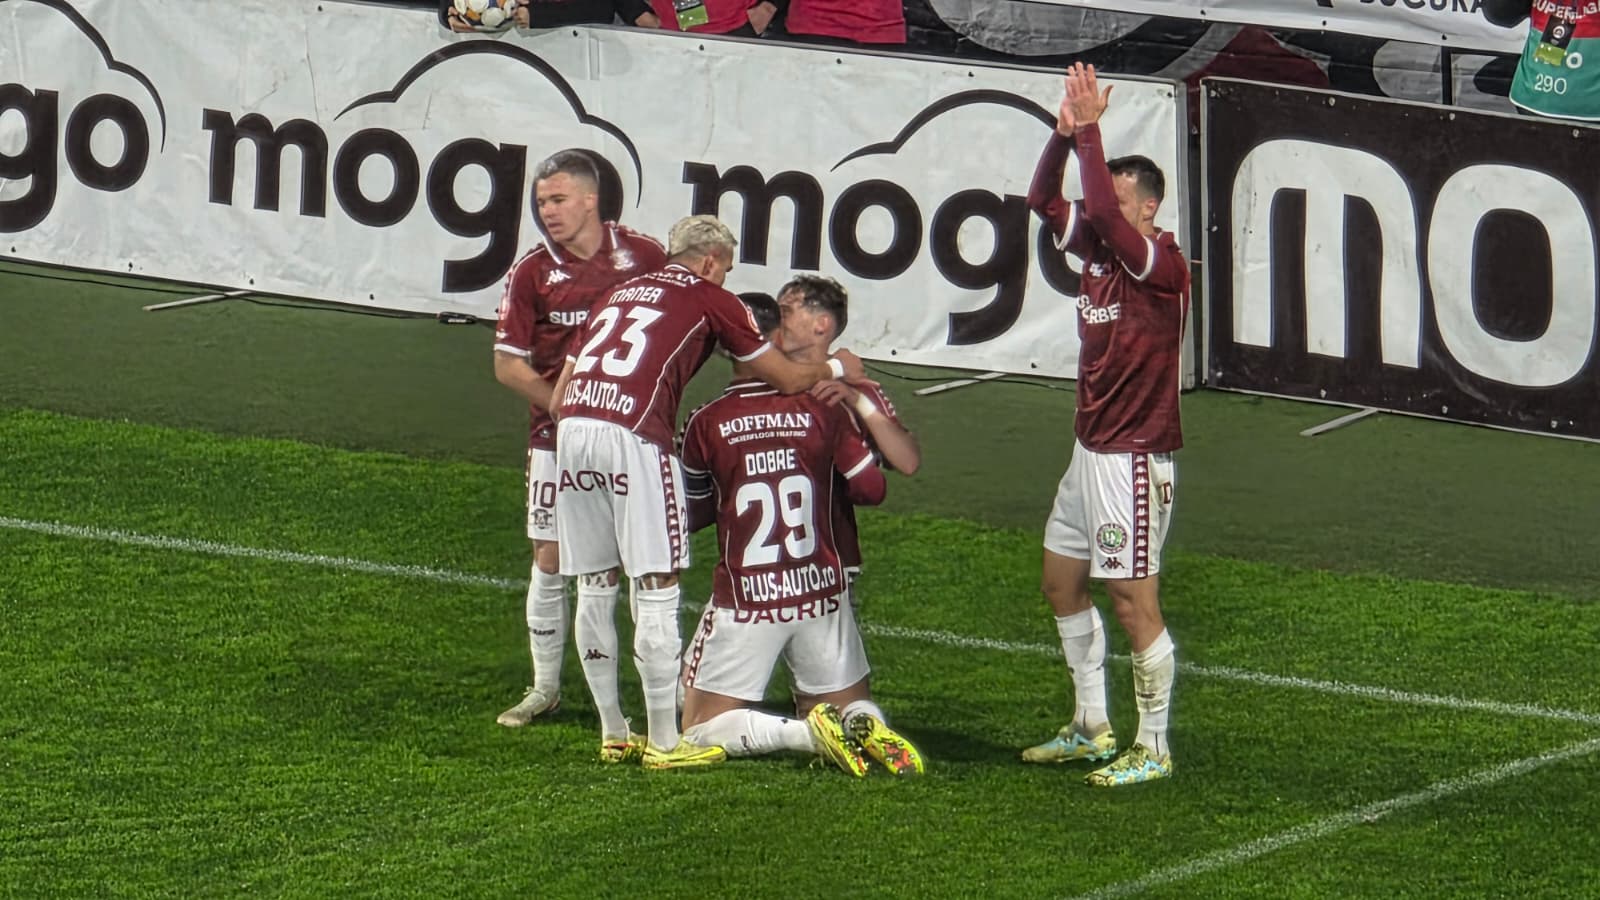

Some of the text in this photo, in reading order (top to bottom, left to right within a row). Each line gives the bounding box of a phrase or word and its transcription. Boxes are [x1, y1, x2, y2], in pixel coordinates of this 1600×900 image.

[1534, 73, 1567, 95] 290
[607, 286, 664, 305] MANEA
[549, 310, 590, 326] SUP
[572, 305, 664, 377] 23
[718, 413, 811, 438] HOFFMAN
[745, 448, 797, 476] DOBRE
[532, 480, 557, 509] 10
[735, 474, 816, 567] 29
